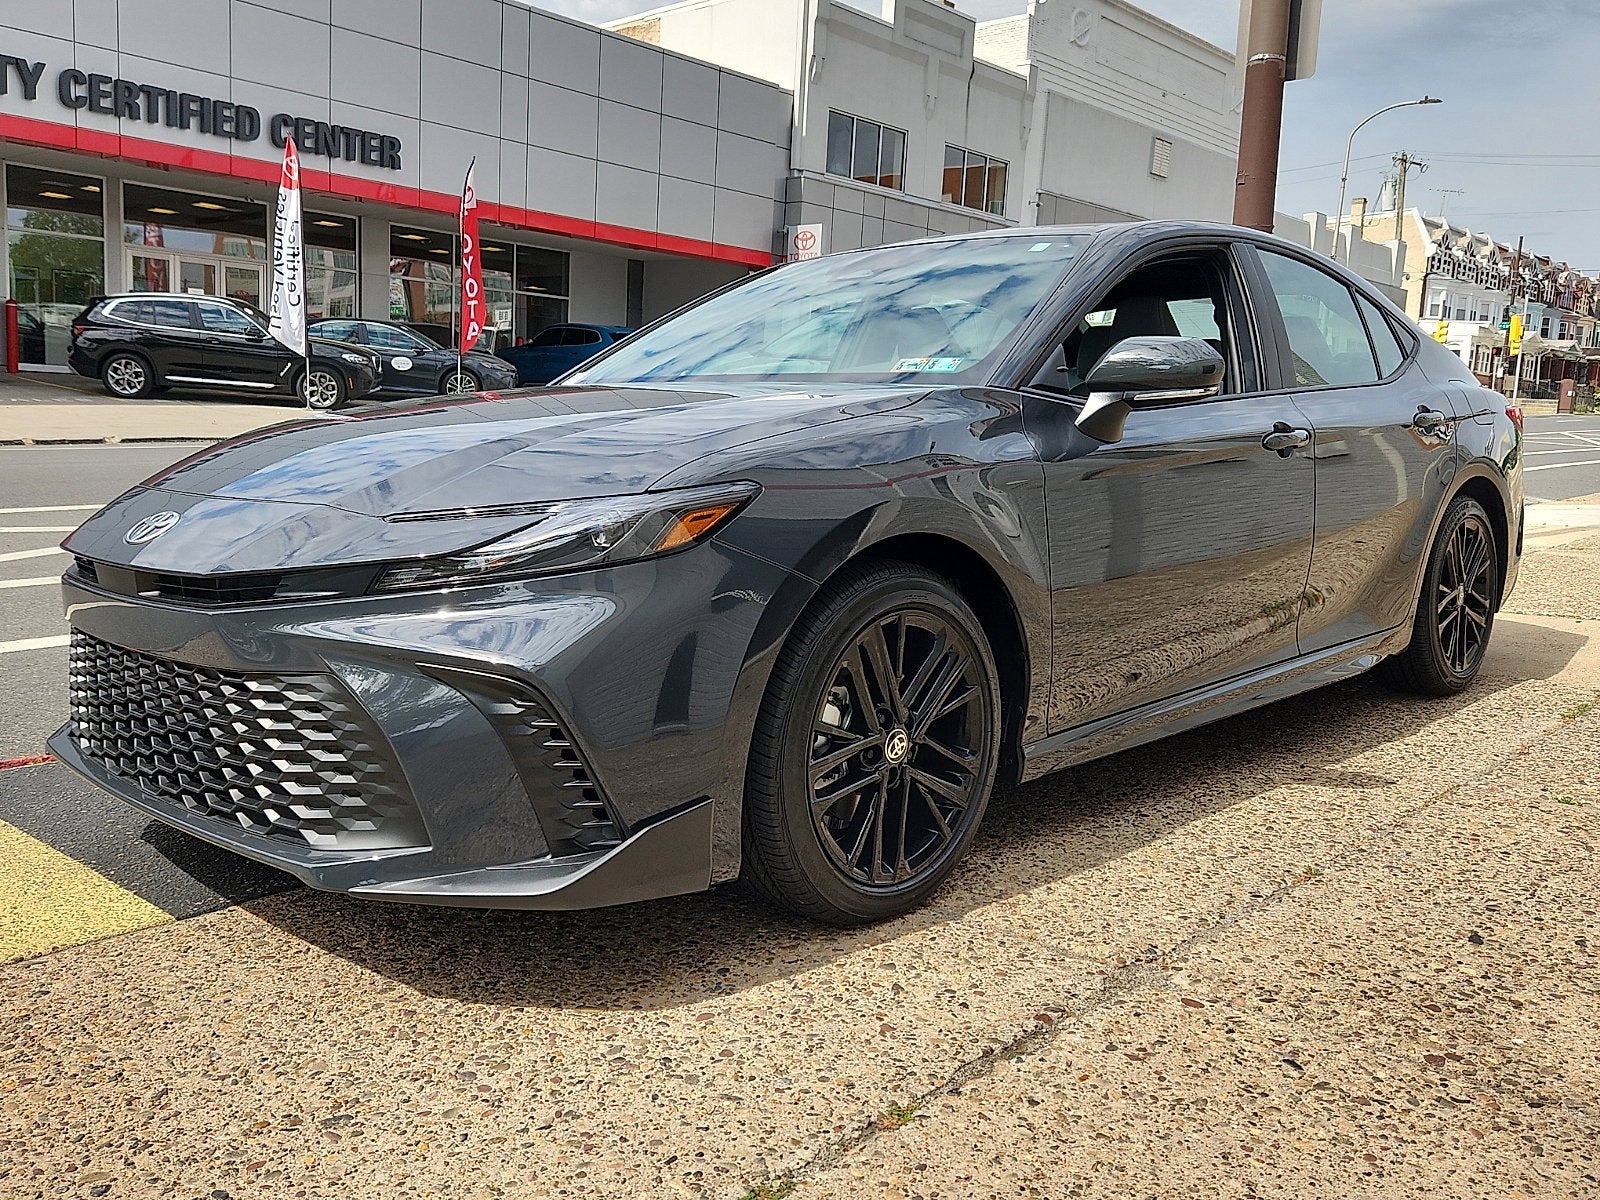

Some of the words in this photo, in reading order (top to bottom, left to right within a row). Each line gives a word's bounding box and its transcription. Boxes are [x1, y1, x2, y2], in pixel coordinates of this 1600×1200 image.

[59, 68, 260, 141] CERTIFIED
[270, 113, 402, 170] CENTER
[463, 209, 480, 341] OYOTA
[790, 252, 818, 260] TOYOTA
